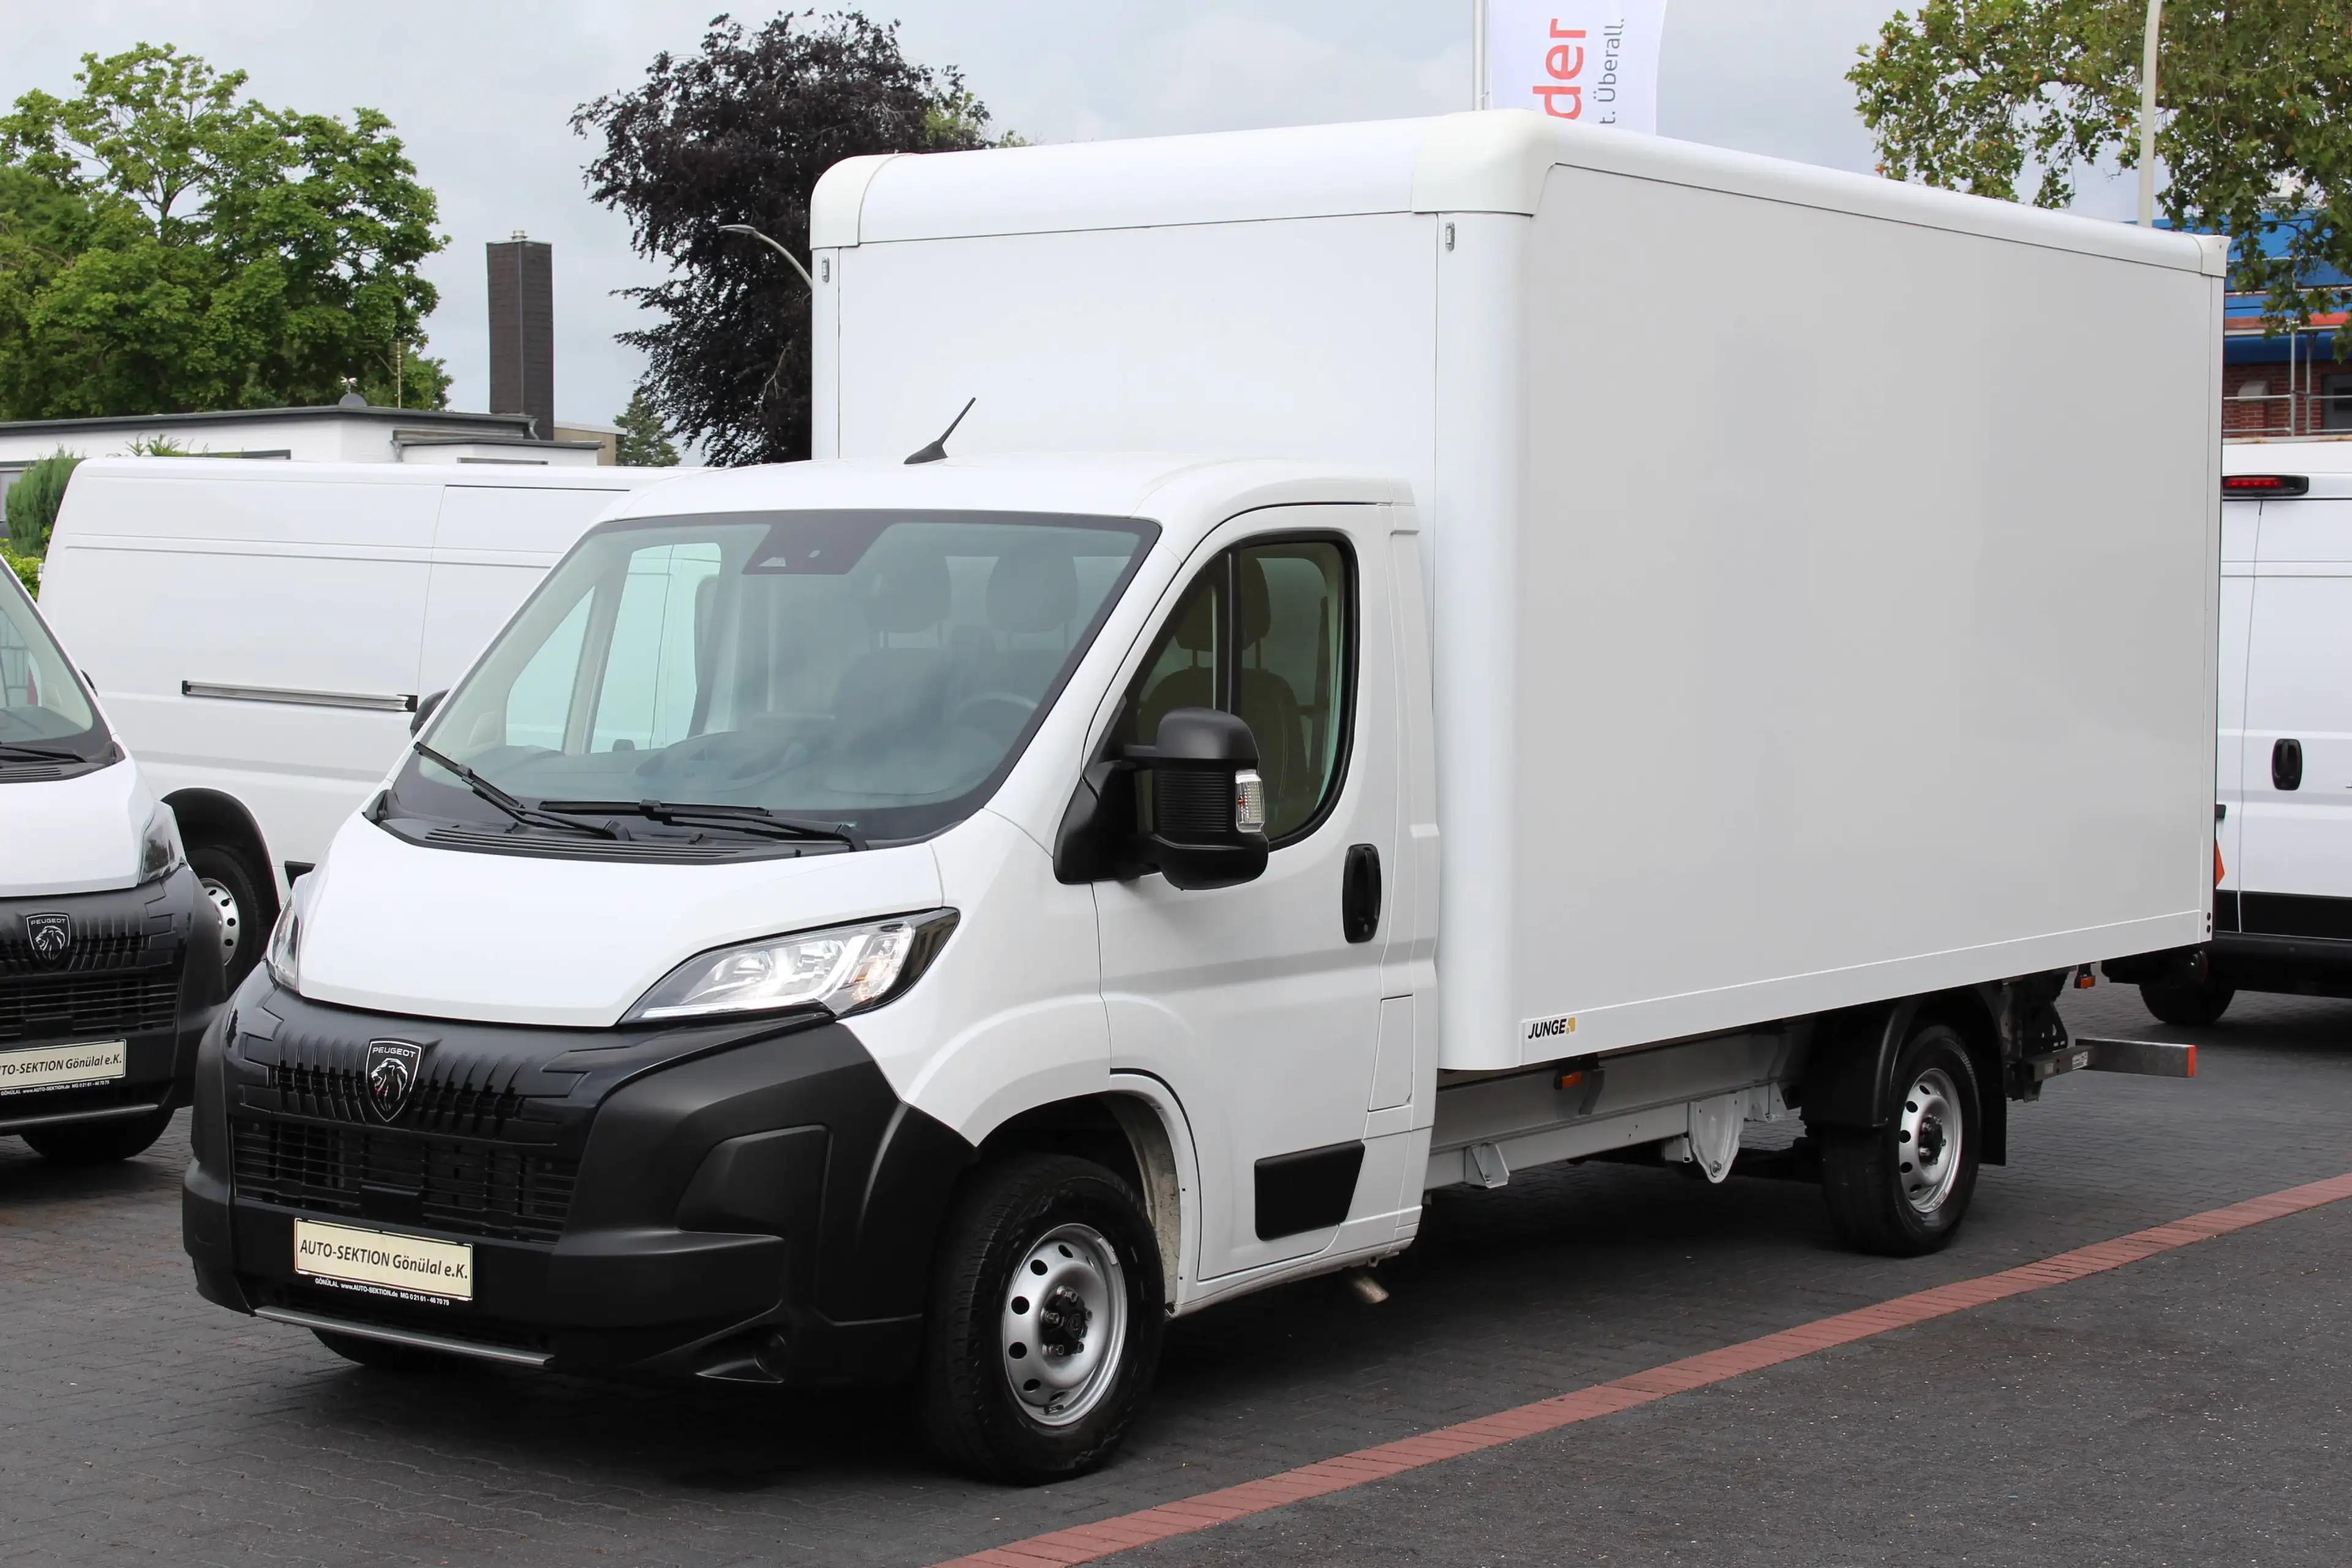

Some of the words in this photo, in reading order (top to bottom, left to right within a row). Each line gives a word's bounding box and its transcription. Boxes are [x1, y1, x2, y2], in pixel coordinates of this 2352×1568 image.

[1532, 18, 1586, 120] der
[1593, 18, 1624, 102] Überall.
[1528, 1018, 1567, 1039] JUNGE
[372, 1046, 416, 1058] PEUGEOT
[0, 1060, 64, 1076] TO-SEKTION
[66, 1055, 104, 1069] Gönülal
[105, 1054, 122, 1065] e.K.
[300, 1239, 390, 1267] AUTO-SEKTION
[393, 1254, 442, 1275] Gönülal
[444, 1264, 468, 1279] e.K.
[315, 1277, 339, 1287] GÖNÜLAL
[341, 1283, 398, 1297] www.AUTO-SEKTION.de
